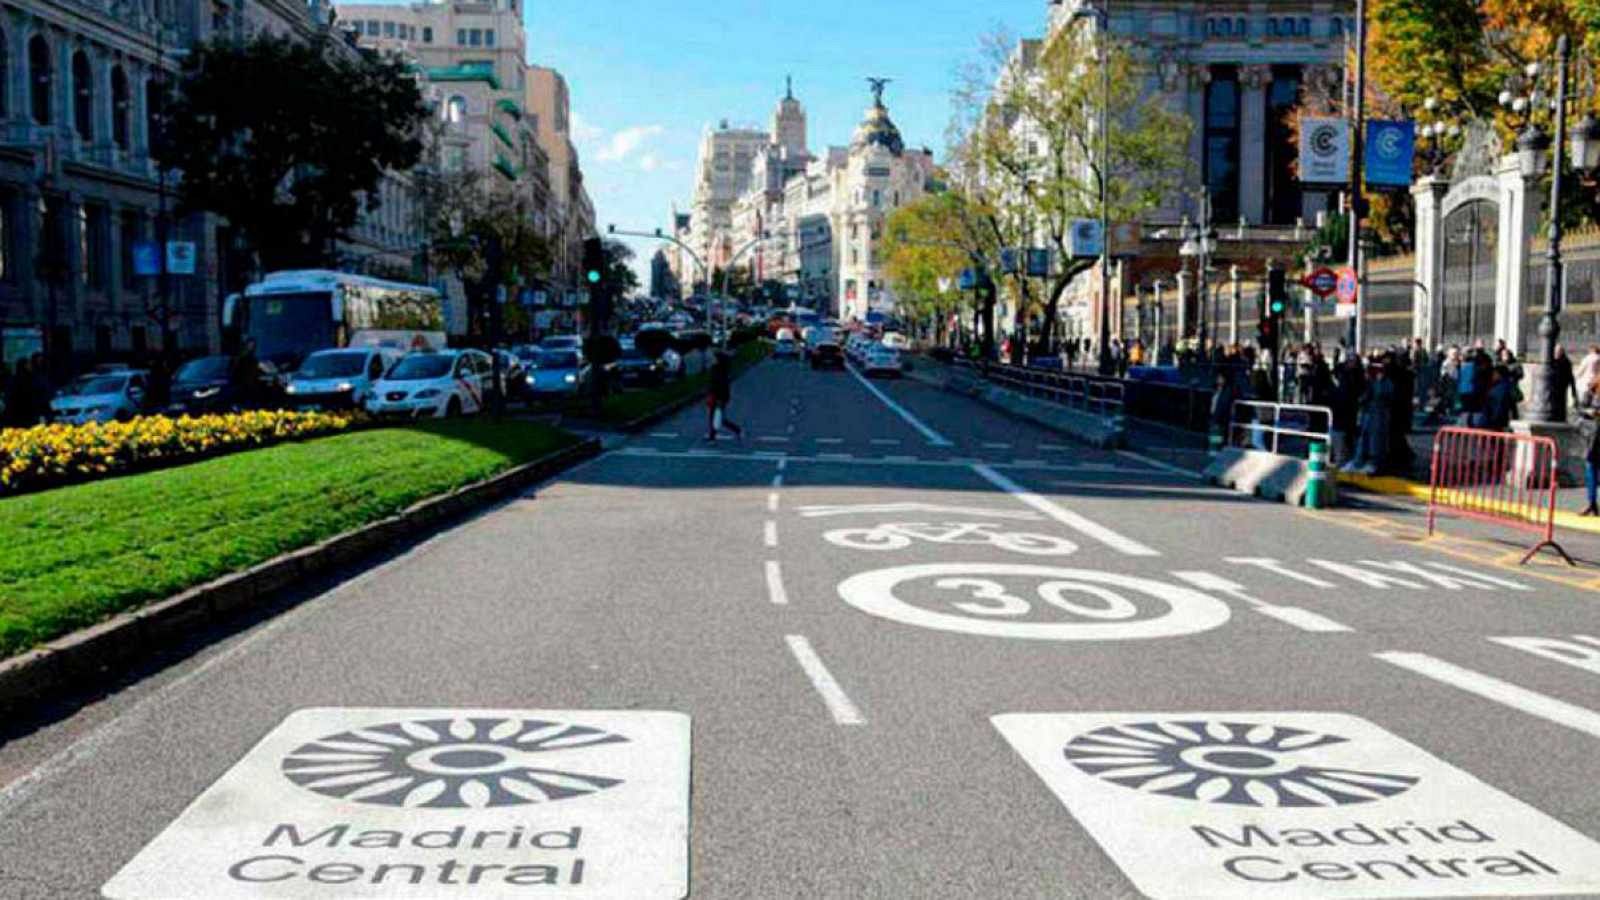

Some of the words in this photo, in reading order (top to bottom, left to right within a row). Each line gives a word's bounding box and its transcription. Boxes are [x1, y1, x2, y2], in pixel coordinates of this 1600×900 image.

[1222, 556, 1535, 590] TAXI
[936, 578, 1137, 618] 30
[262, 823, 583, 850] Madrid
[1191, 820, 1496, 848] Madrid
[227, 854, 585, 885] Central
[1222, 850, 1560, 883] Central
